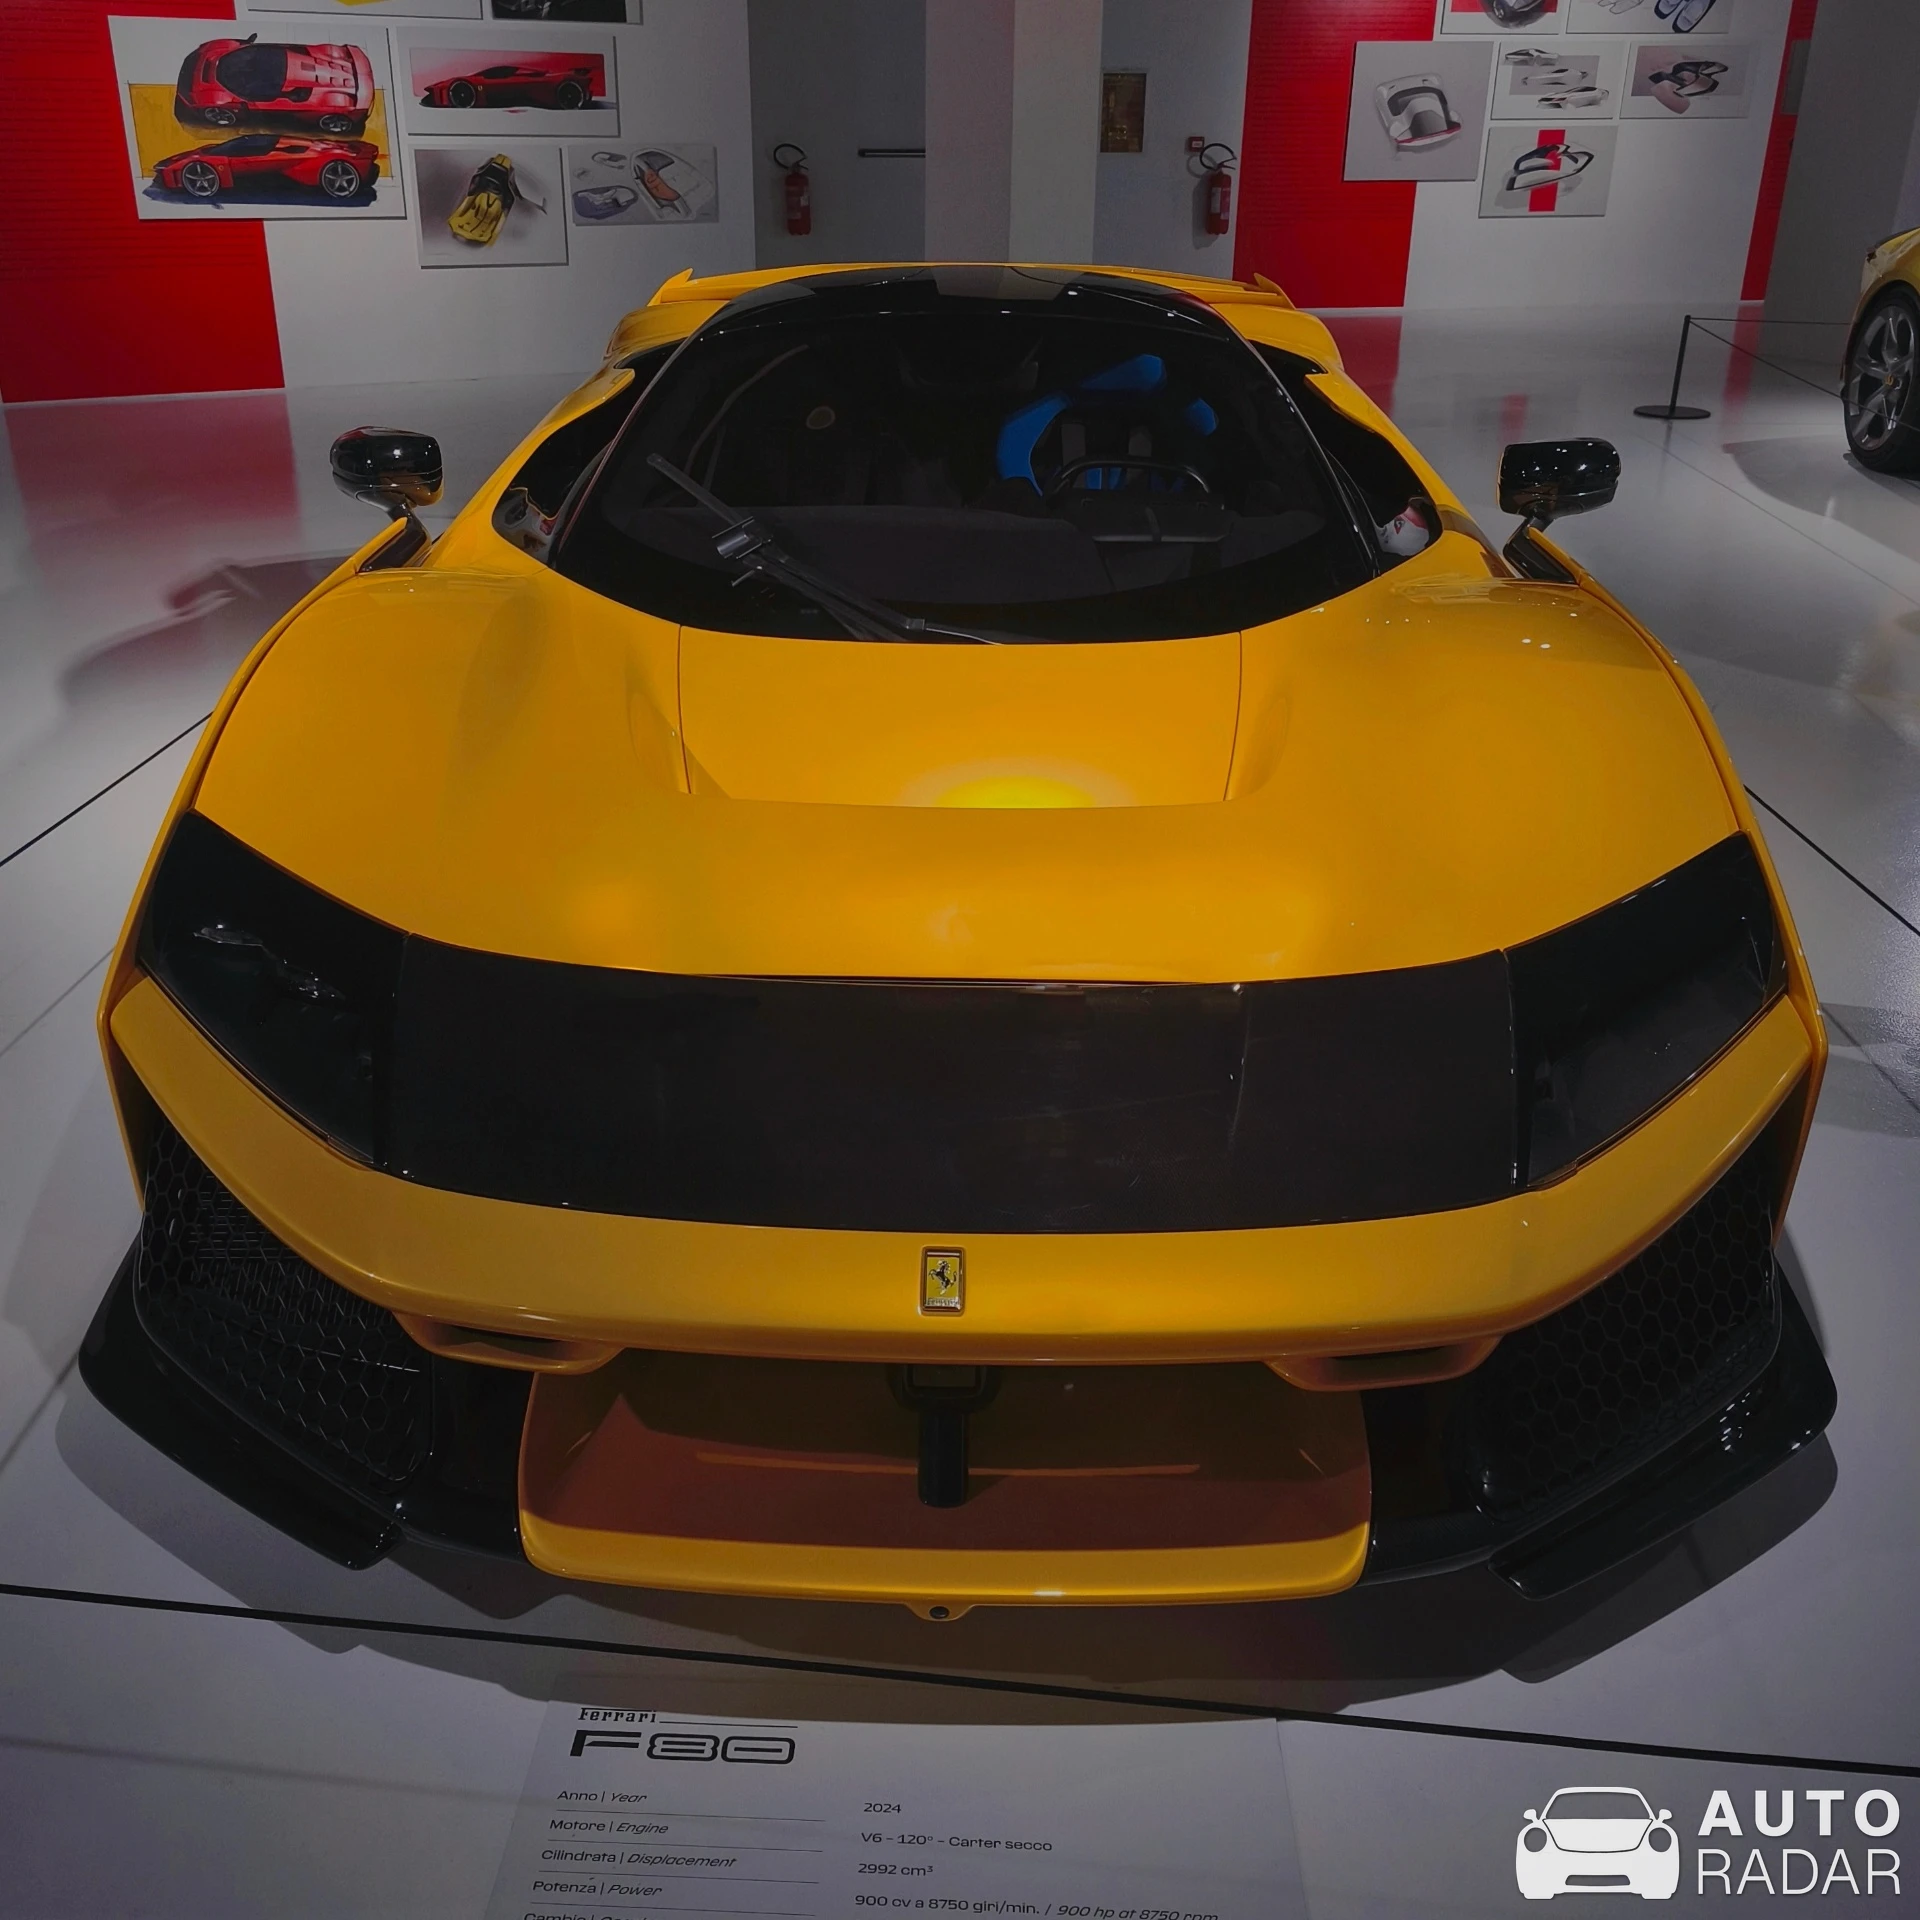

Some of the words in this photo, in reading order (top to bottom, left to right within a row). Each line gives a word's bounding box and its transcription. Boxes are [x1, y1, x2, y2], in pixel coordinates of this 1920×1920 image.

[578, 1707, 657, 1723] Ferrari
[569, 1729, 796, 1765] F80
[556, 1790, 598, 1802] Anno
[610, 1792, 648, 1803] Year
[863, 1802, 902, 1814] 2024
[549, 1819, 606, 1832] Motore
[616, 1822, 669, 1835] Engine
[860, 1832, 882, 1844] V6
[948, 1836, 1002, 1849] Carter
[1004, 1840, 1053, 1852] secco
[541, 1849, 617, 1864] Cilindrata
[626, 1853, 738, 1868] Displacement
[857, 1862, 898, 1875] 2992
[532, 1880, 597, 1895] Potenza
[606, 1884, 663, 1898] Power
[854, 1894, 888, 1907] 900
[891, 1899, 912, 1909] cv
[914, 1900, 925, 1909] a
[928, 1898, 969, 1911] 8750
[972, 1899, 1041, 1916] giri/min.
[1056, 1904, 1091, 1917] 900
[1093, 1906, 1116, 1920] hp
[1118, 1909, 1138, 1920] at
[1138, 1909, 1181, 1920] 8750
